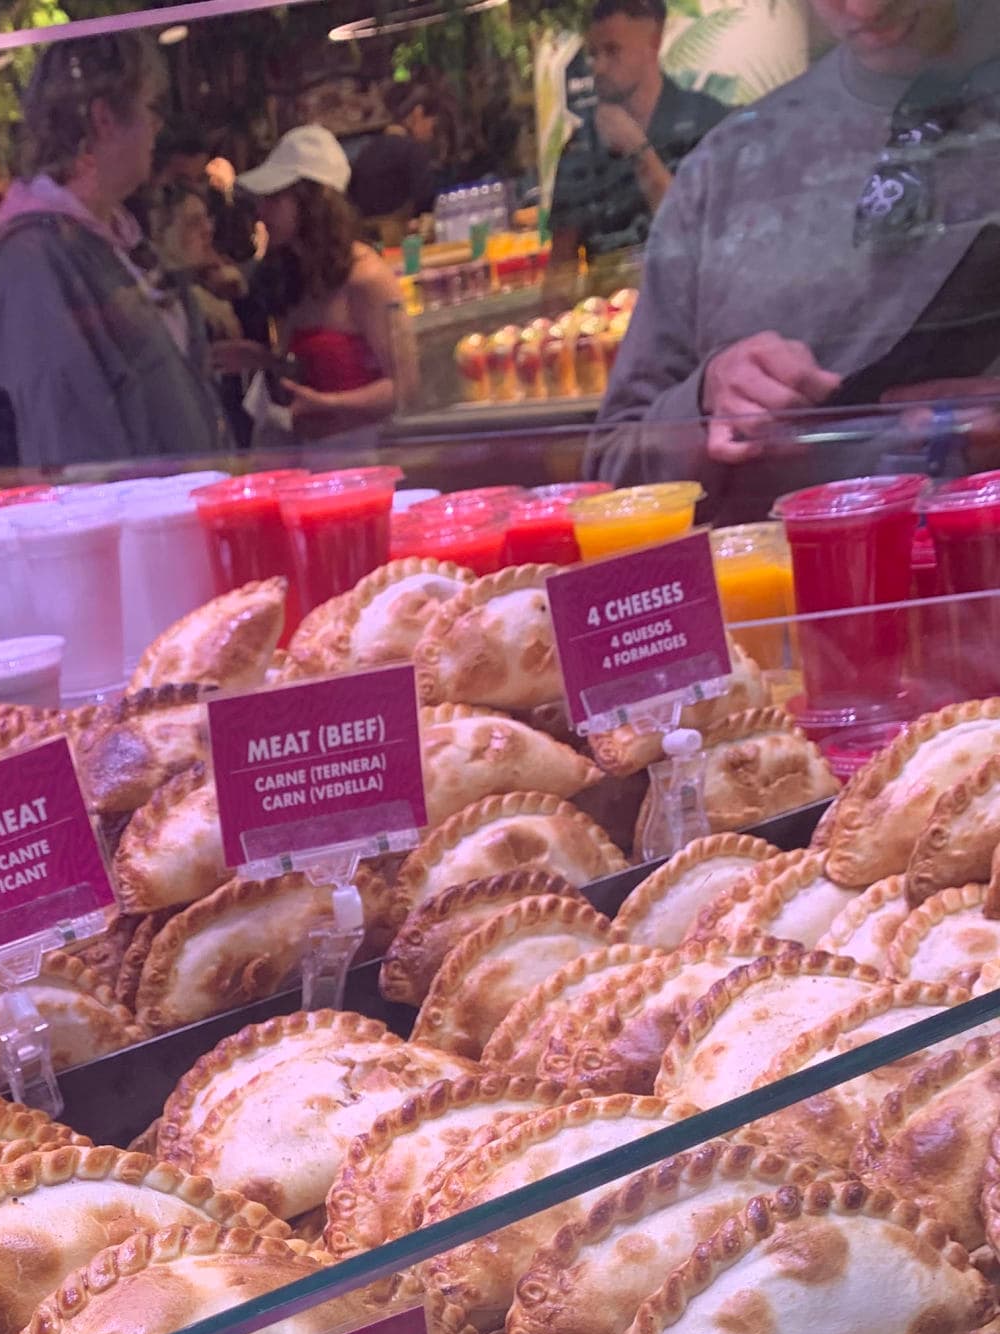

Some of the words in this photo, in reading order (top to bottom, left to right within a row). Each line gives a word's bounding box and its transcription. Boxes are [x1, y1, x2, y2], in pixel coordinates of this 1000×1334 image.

[587, 606, 600, 626] 4
[605, 581, 684, 622] CHEESES
[602, 656, 612, 669] 4
[614, 633, 687, 667] FORMATGES
[611, 635, 620, 648] 4
[622, 619, 673, 645] QUESOS
[247, 729, 310, 763] MEAT
[318, 714, 385, 753] (BEEF)
[254, 769, 307, 793] CARNE
[310, 752, 386, 783] (TERNERA)
[262, 790, 306, 811] CARN
[310, 774, 383, 805] (VEDELLA)
